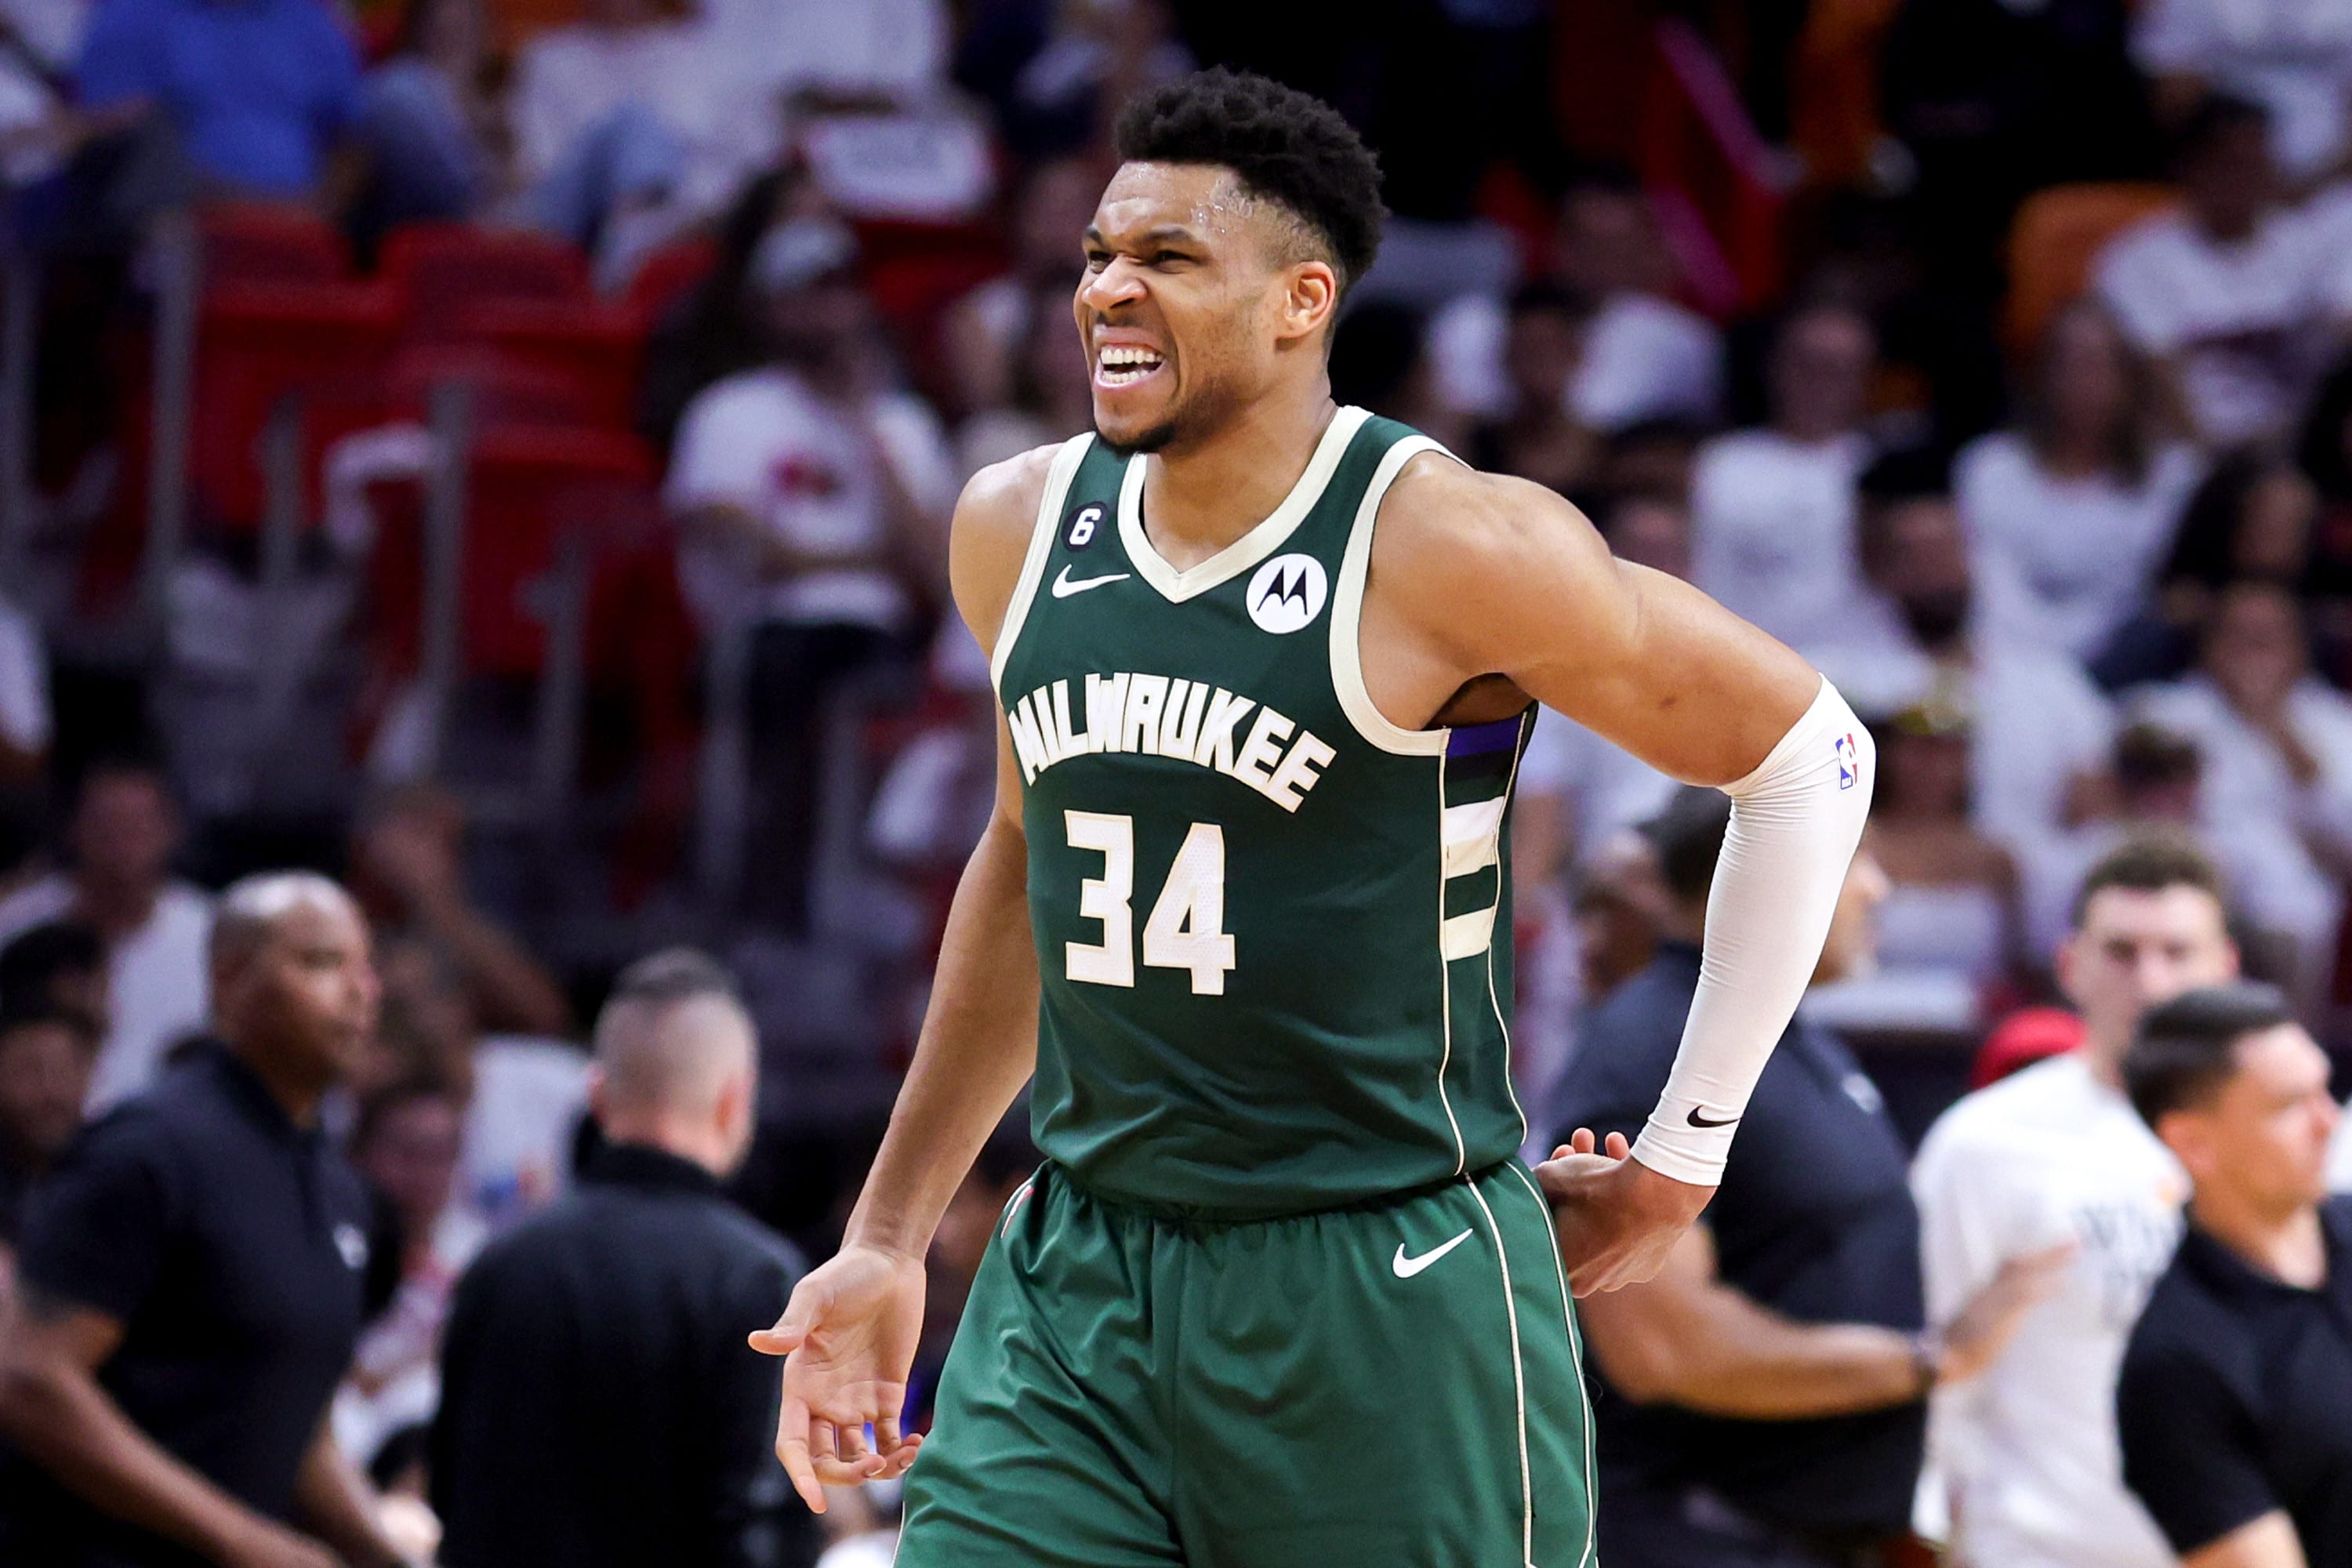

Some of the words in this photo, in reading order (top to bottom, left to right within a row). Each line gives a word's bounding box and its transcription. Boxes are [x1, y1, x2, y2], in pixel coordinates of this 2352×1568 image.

[1069, 507, 1102, 546] 6
[1008, 672, 1337, 813] MILWAUKEE
[1063, 809, 1236, 996] 34
